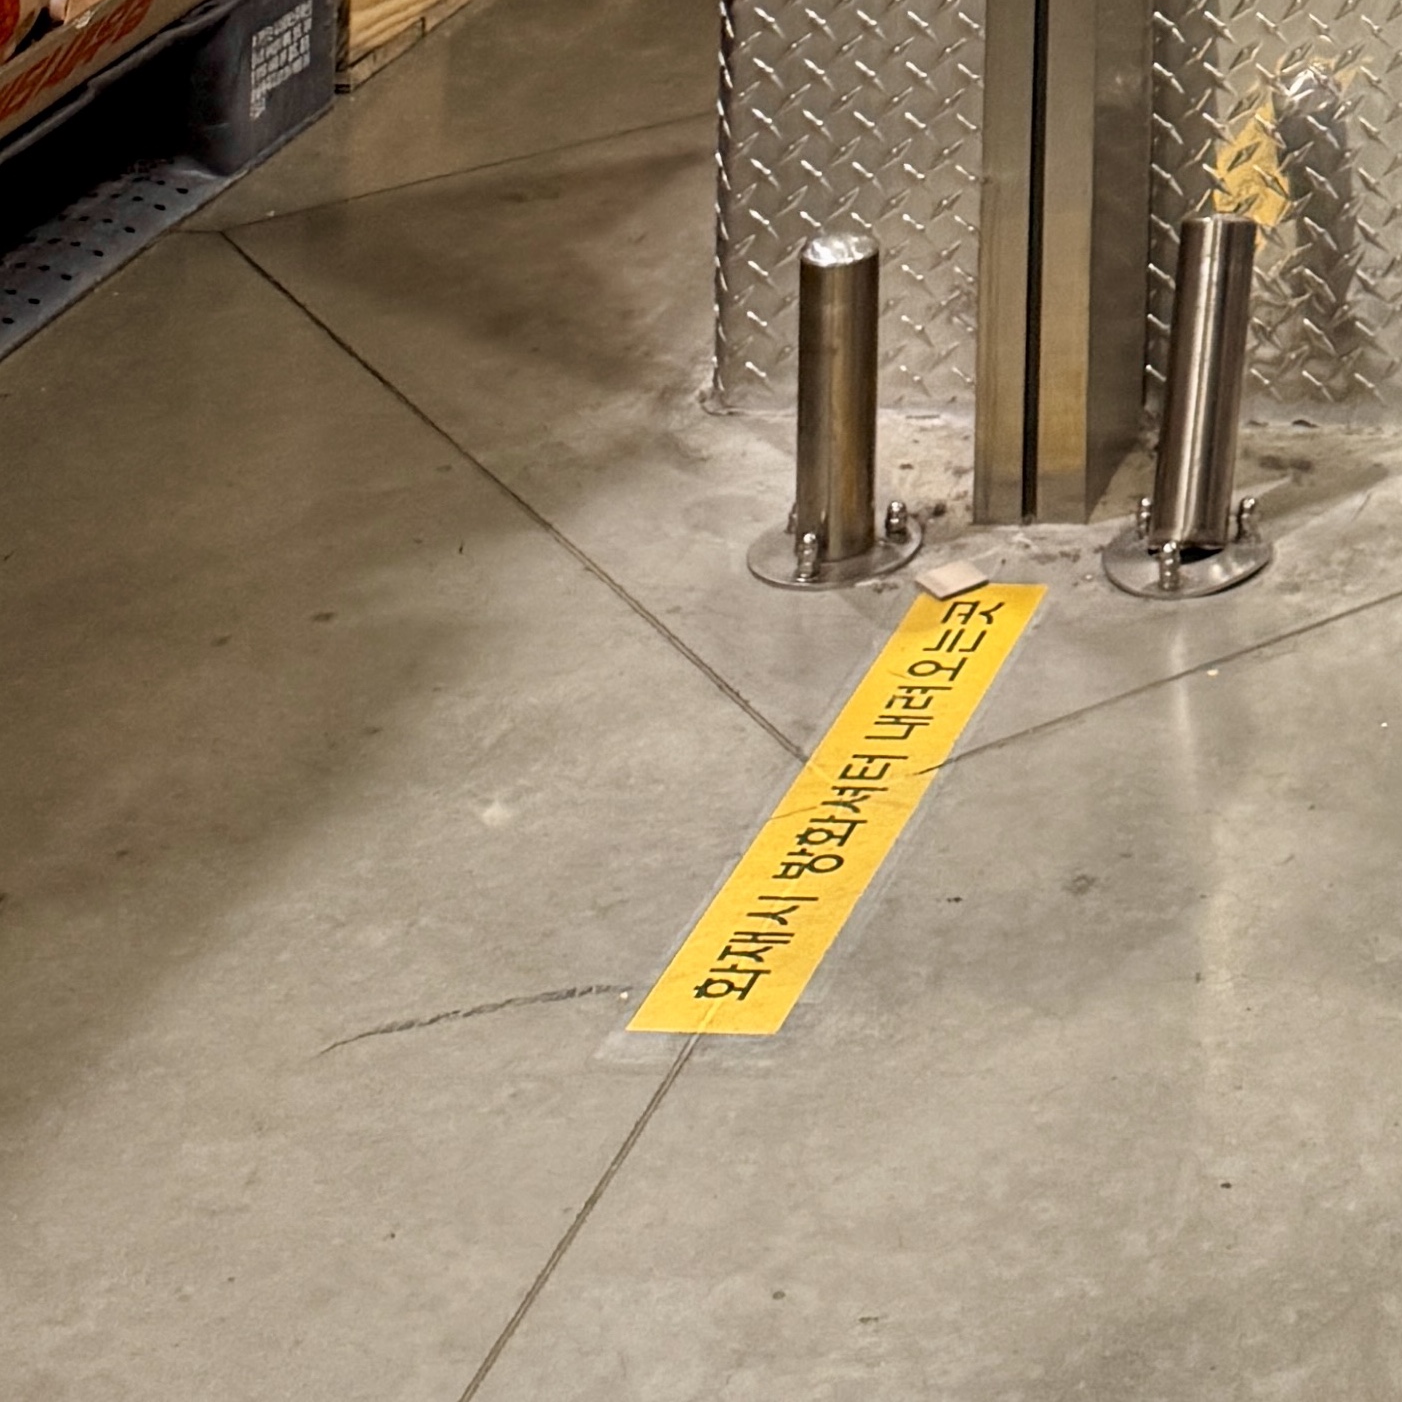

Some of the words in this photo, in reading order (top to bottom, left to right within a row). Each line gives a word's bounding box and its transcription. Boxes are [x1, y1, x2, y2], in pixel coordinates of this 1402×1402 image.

[693, 894, 820, 1002] 화재시
[772, 753, 909, 880] 방화셔터
[864, 600, 1006, 741] 내려오는곳
